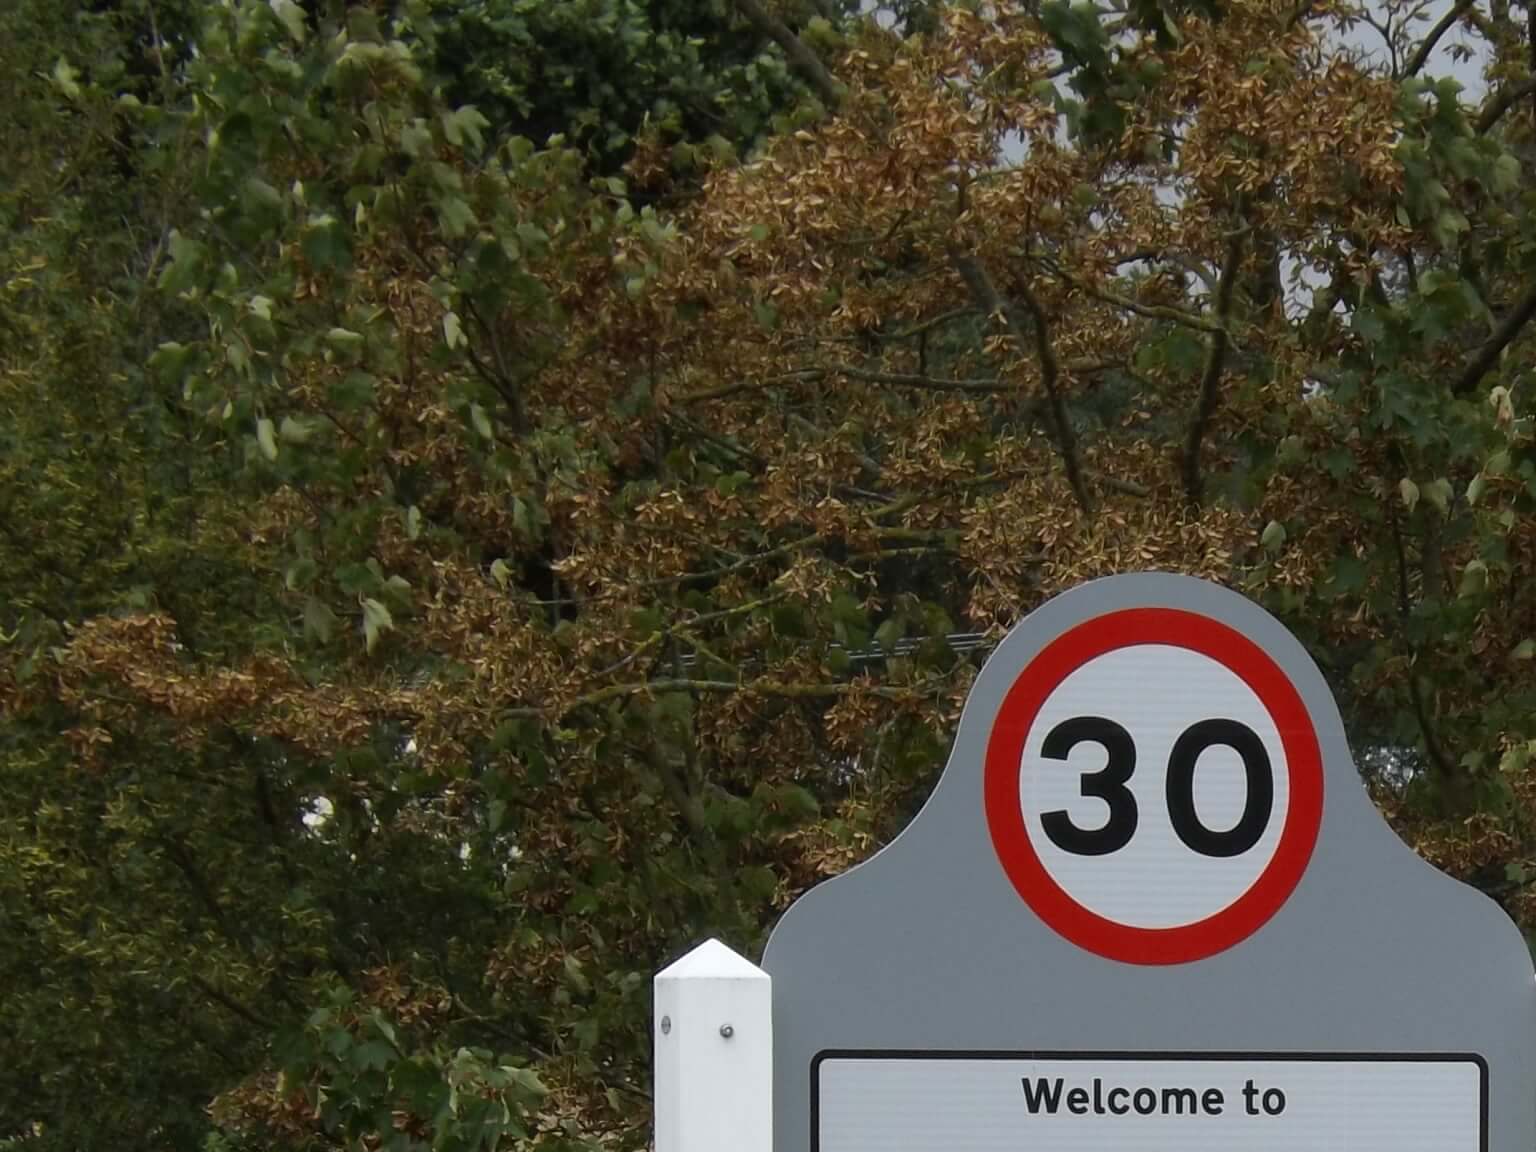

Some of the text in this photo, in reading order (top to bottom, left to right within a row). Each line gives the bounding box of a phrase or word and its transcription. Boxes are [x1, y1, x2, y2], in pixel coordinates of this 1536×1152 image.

[1038, 716, 1274, 857] 30
[1021, 1077, 1287, 1116] Welcome to
